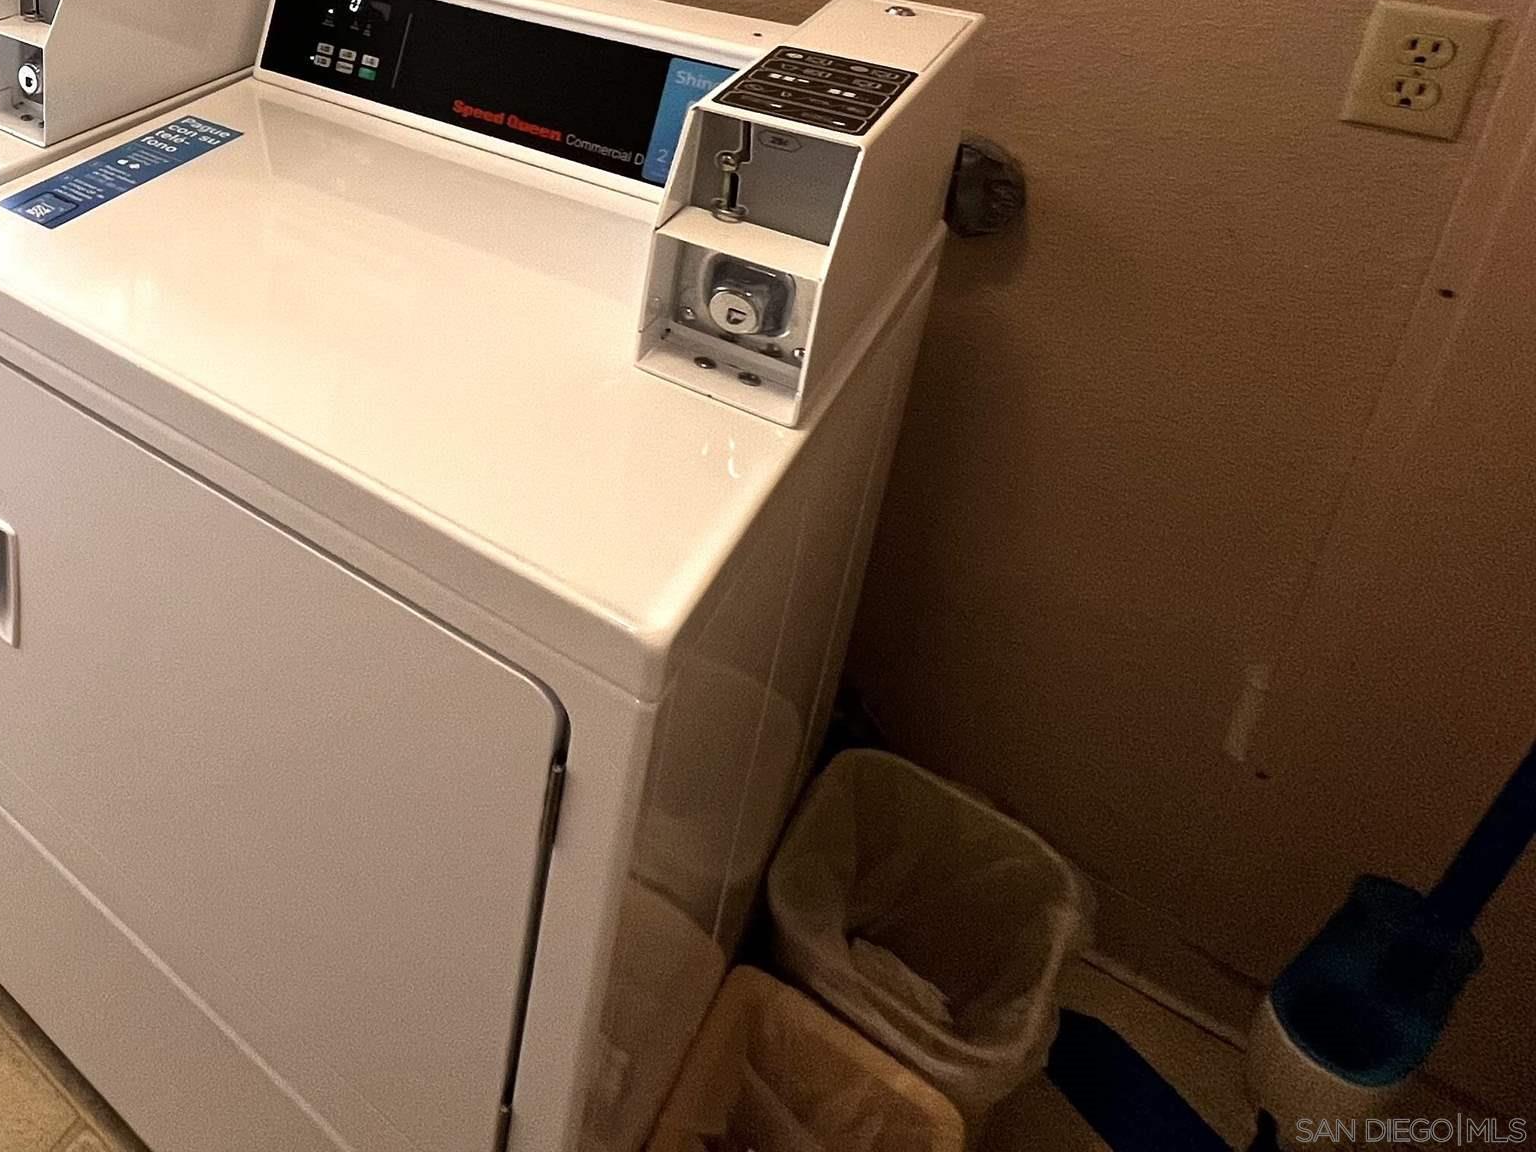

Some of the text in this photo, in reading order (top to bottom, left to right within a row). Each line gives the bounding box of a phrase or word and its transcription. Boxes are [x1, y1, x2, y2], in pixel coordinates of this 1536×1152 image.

[168, 124, 221, 145] con su
[181, 117, 231, 138] Pague
[452, 99, 506, 125] Speed
[507, 114, 562, 142] Queen
[565, 133, 632, 162] Commercial
[141, 136, 177, 152] fono
